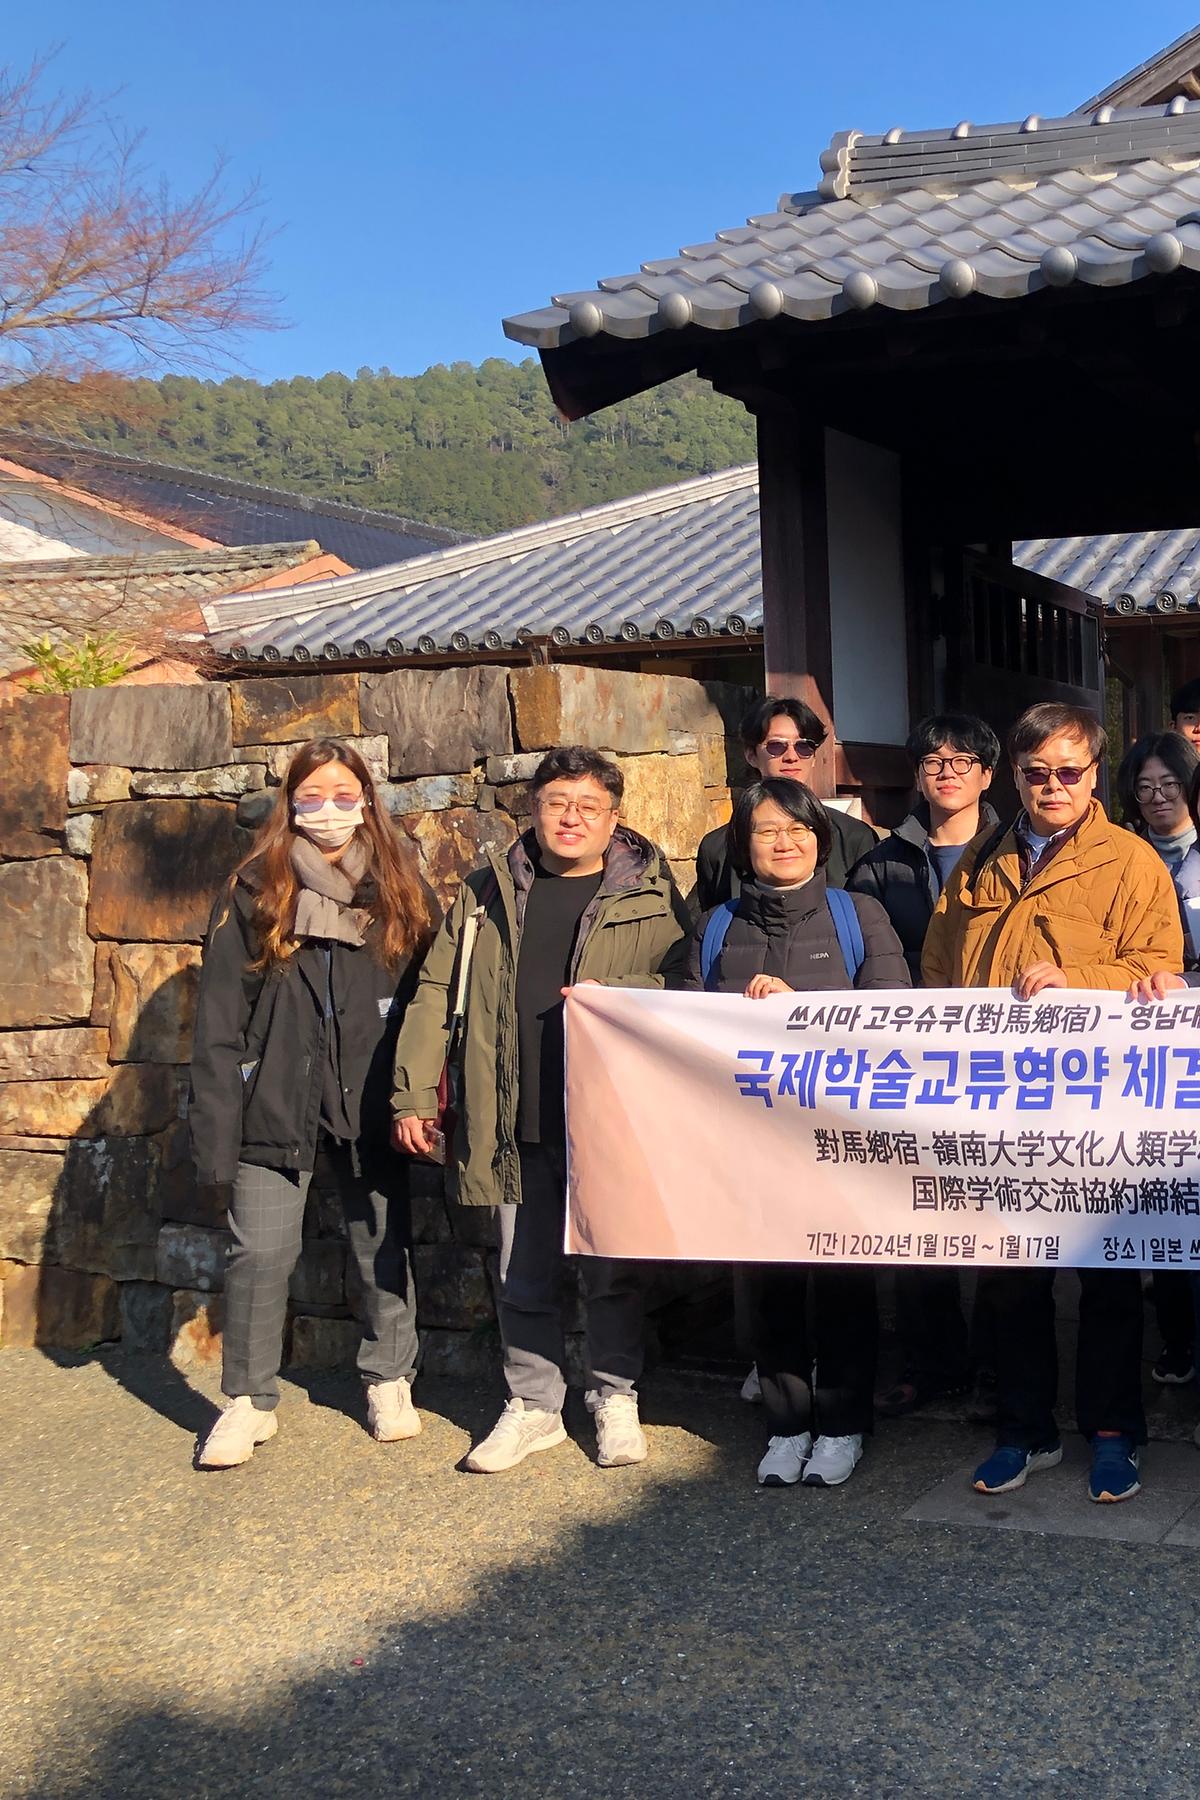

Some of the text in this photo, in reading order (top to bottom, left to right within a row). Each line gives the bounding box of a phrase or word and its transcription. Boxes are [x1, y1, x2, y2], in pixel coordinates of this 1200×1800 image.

[786, 1004, 862, 1033] 쓰시마
[734, 1046, 1109, 1110] 국제학술교류협약
[806, 1232, 838, 1256] 기간
[850, 1234, 911, 1258] 2024년
[918, 1234, 938, 1258] 1월
[944, 1235, 976, 1259] 15일
[1000, 1235, 1021, 1260] 1월
[1027, 1236, 1061, 1260] 17일
[1102, 1237, 1138, 1262] 장소
[1149, 1238, 1183, 1263] 일본
